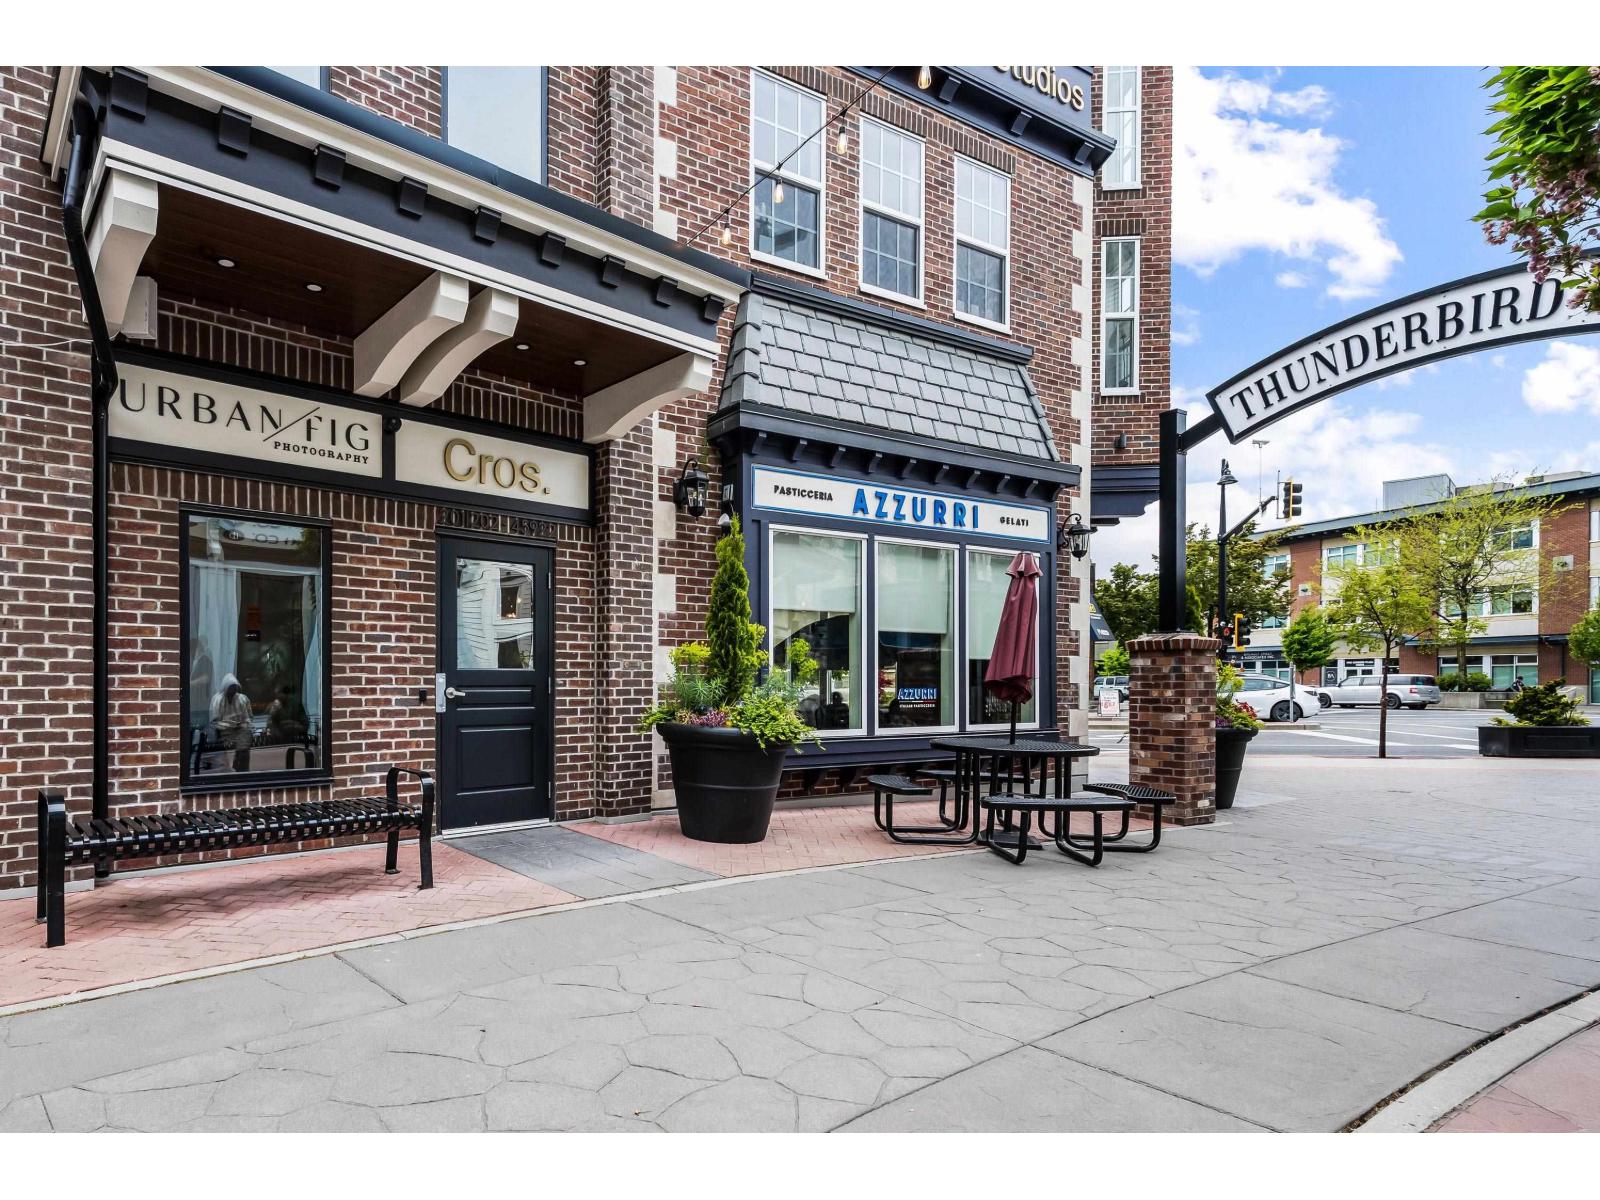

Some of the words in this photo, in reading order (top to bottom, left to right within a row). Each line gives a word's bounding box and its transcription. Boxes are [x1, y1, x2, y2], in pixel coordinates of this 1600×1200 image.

[1229, 277, 1564, 420] THUNDERBIRD
[274, 441, 369, 464] PHOTOGRAPHY
[444, 438, 550, 494] Cros.
[773, 484, 833, 502] PASTICCERIA
[853, 488, 979, 529] AZZURRI
[999, 515, 1029, 527] GELATI
[897, 687, 937, 700] AZZURRI
